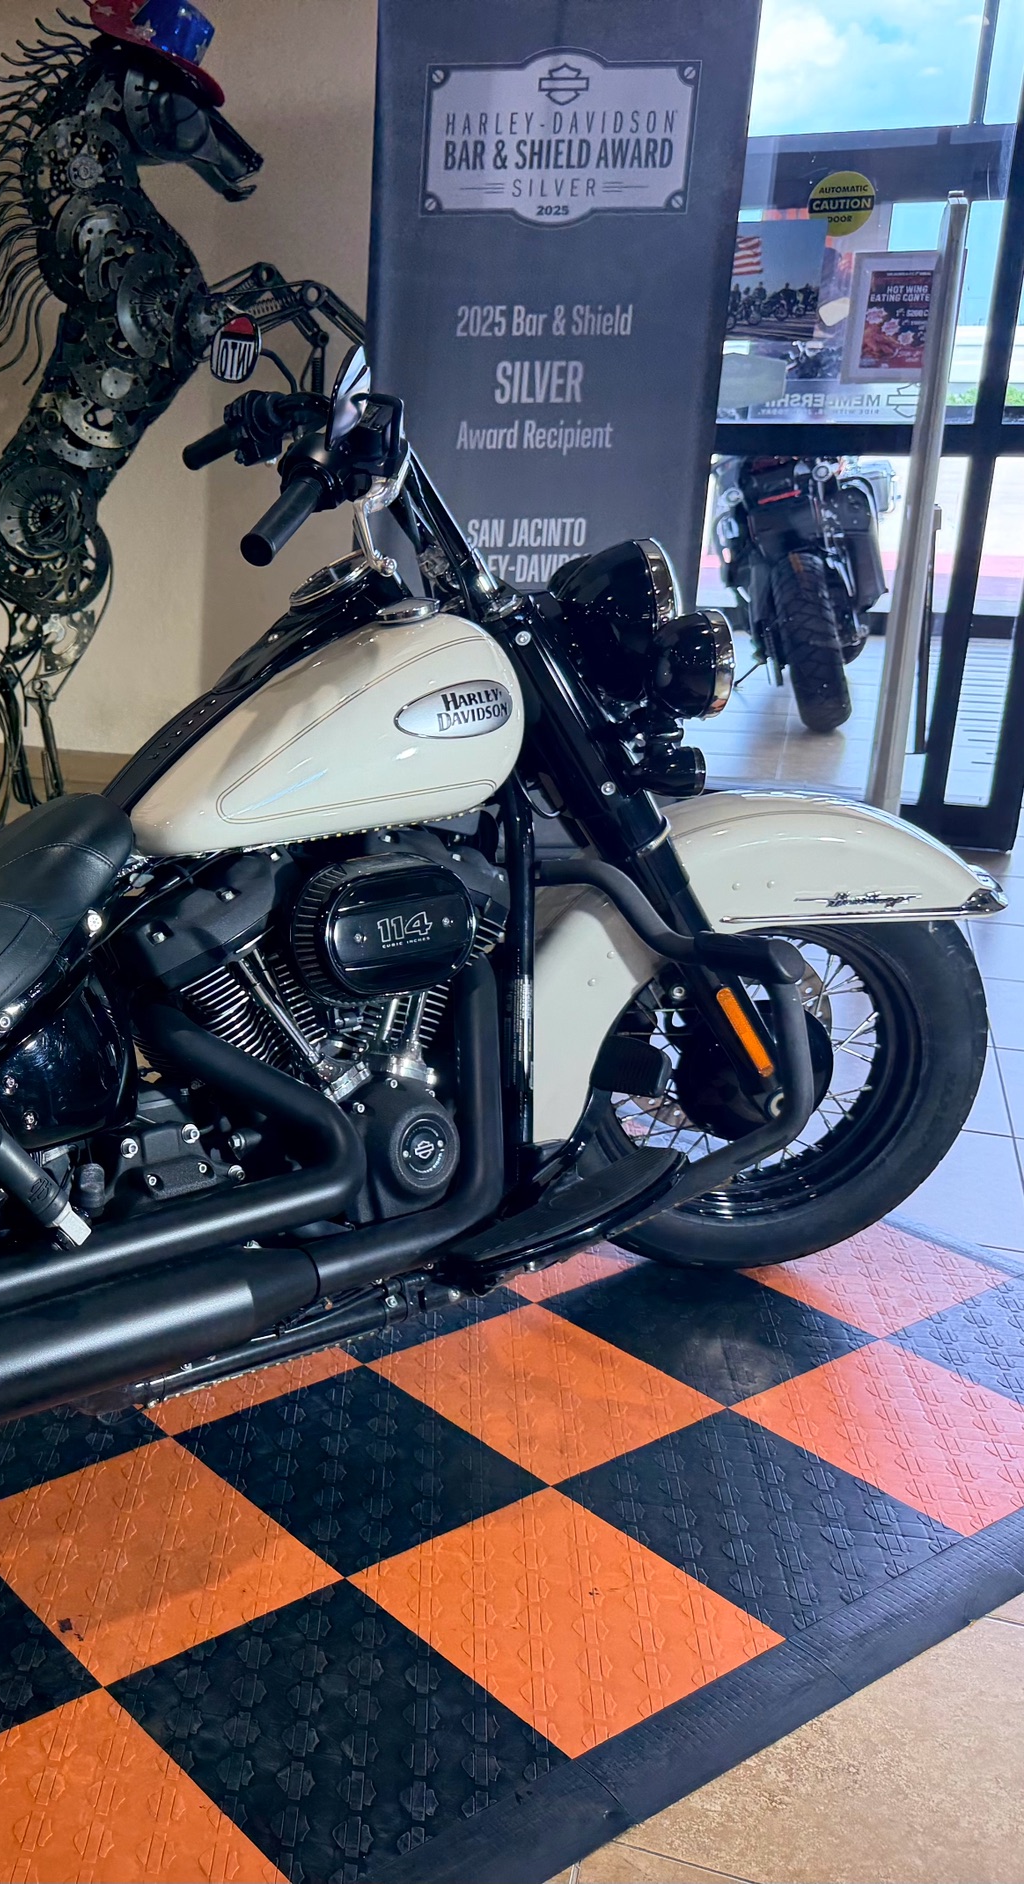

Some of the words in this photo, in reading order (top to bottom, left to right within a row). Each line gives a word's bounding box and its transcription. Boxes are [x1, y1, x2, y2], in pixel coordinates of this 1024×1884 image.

[445, 110, 676, 136] HARLEY-DAVIDSON
[444, 139, 486, 171] BAR
[493, 139, 508, 170] &
[514, 138, 591, 170] SHIELD
[595, 137, 675, 169] AWARD
[512, 178, 596, 198] SILVER
[818, 184, 869, 194] AUTOMATIC
[536, 205, 569, 216] 2025
[812, 198, 872, 212] CAUTION
[870, 293, 901, 302] EATING
[902, 293, 931, 302] CONTE
[886, 285, 905, 294] HOT
[906, 285, 929, 294] WING
[456, 305, 507, 337] 2025
[511, 305, 548, 337] Bar
[552, 304, 566, 336] &
[571, 304, 633, 336] Shield
[494, 360, 584, 404] SILVER
[456, 420, 519, 450] Award
[523, 419, 613, 456] Recipient
[467, 518, 505, 548] SAN
[508, 517, 587, 548] JACINTO
[436, 702, 508, 732] DAVIDSON
[377, 911, 433, 943] 114
[382, 941, 403, 949] CUBIC
[406, 936, 431, 945] INCHES
